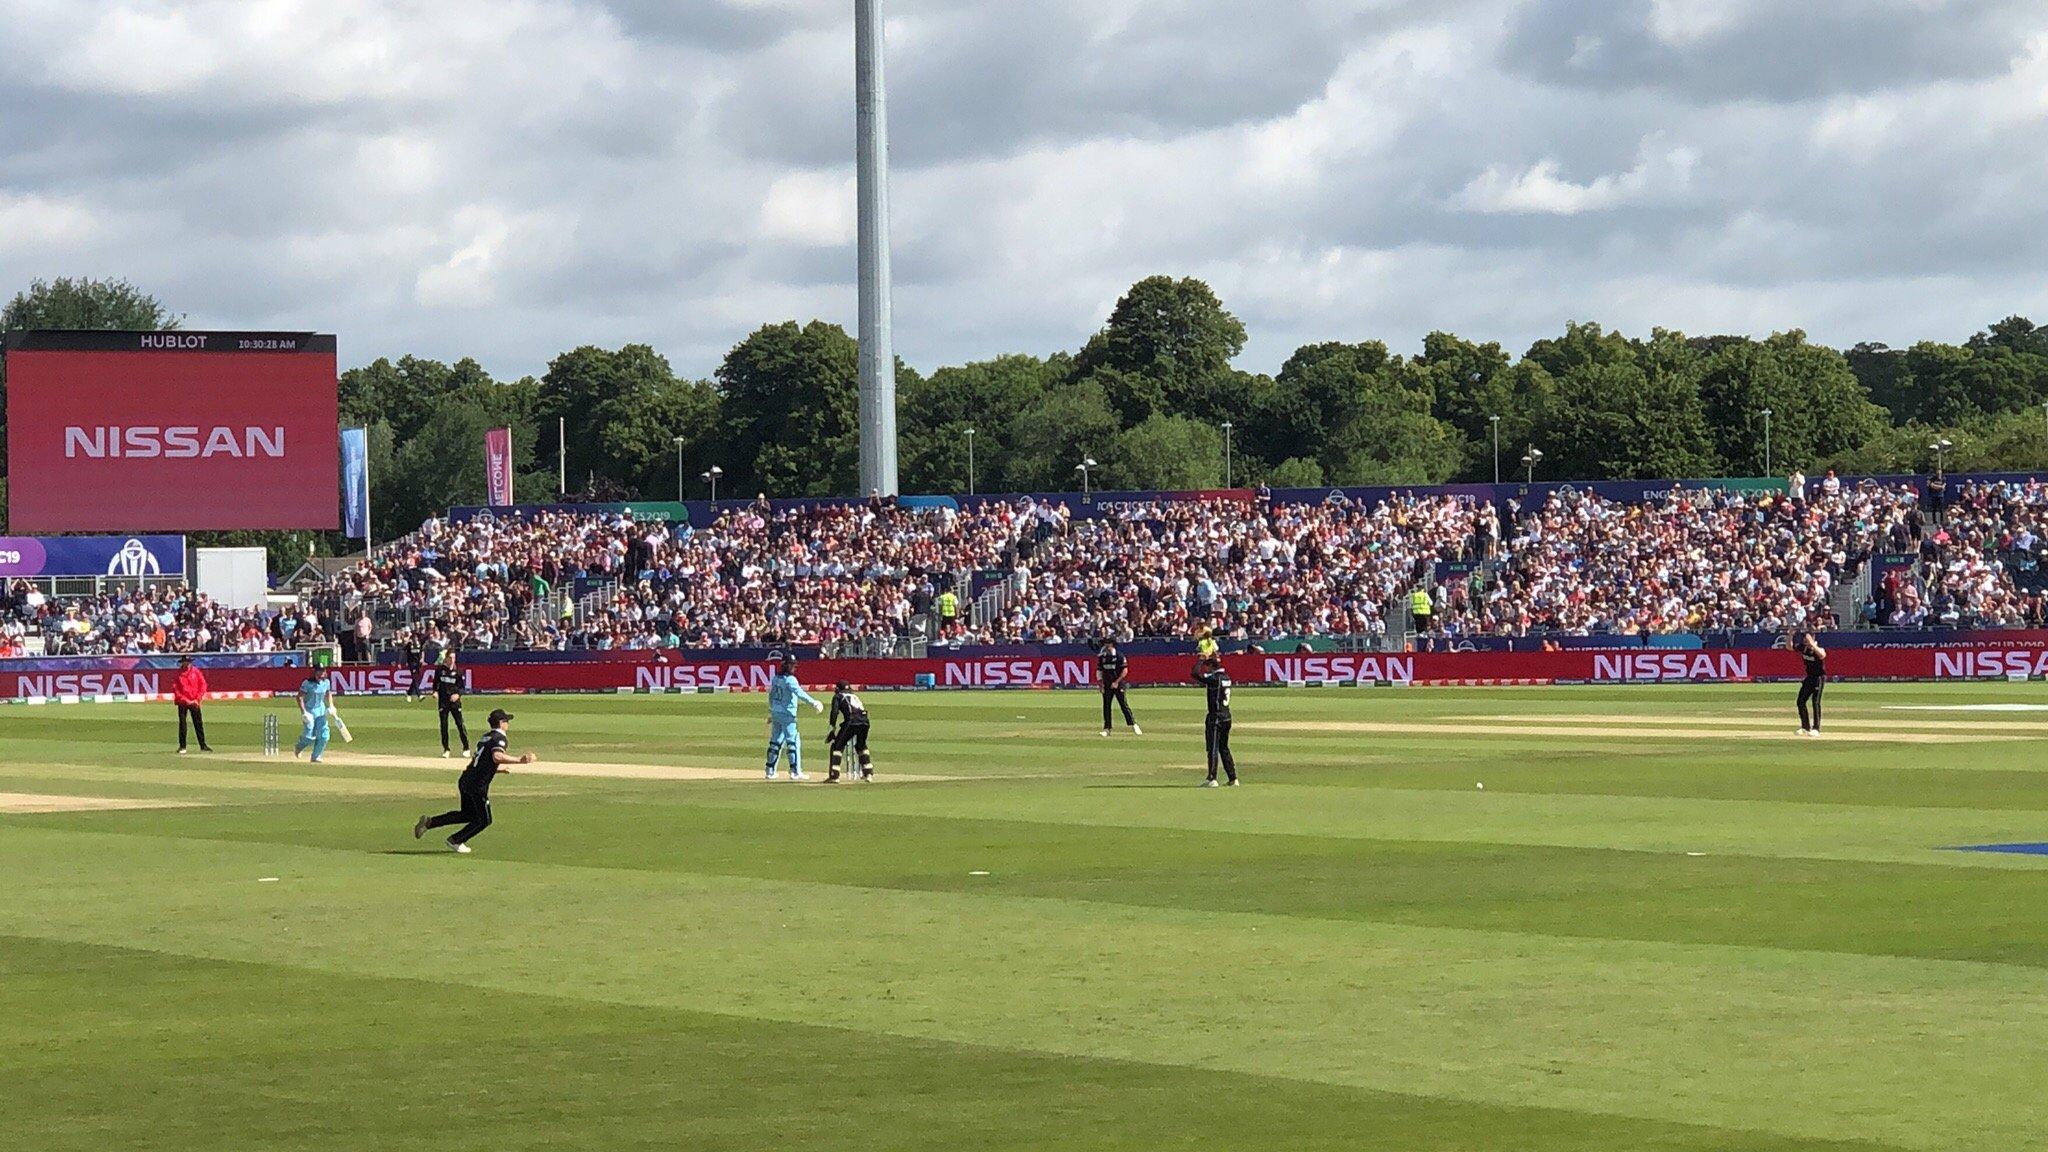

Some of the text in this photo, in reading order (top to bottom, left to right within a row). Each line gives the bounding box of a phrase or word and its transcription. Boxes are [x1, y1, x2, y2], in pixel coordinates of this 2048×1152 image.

[141, 335, 296, 349] HUBLOT 10:30:28 AM
[65, 426, 285, 458] NISSAN
[636, 664, 776, 688] NISSAN
[945, 661, 1089, 685] NISSAN
[1264, 657, 1414, 681] NISSAN
[1594, 653, 1748, 679] NISSAN
[18, 673, 158, 698] NISSAN
